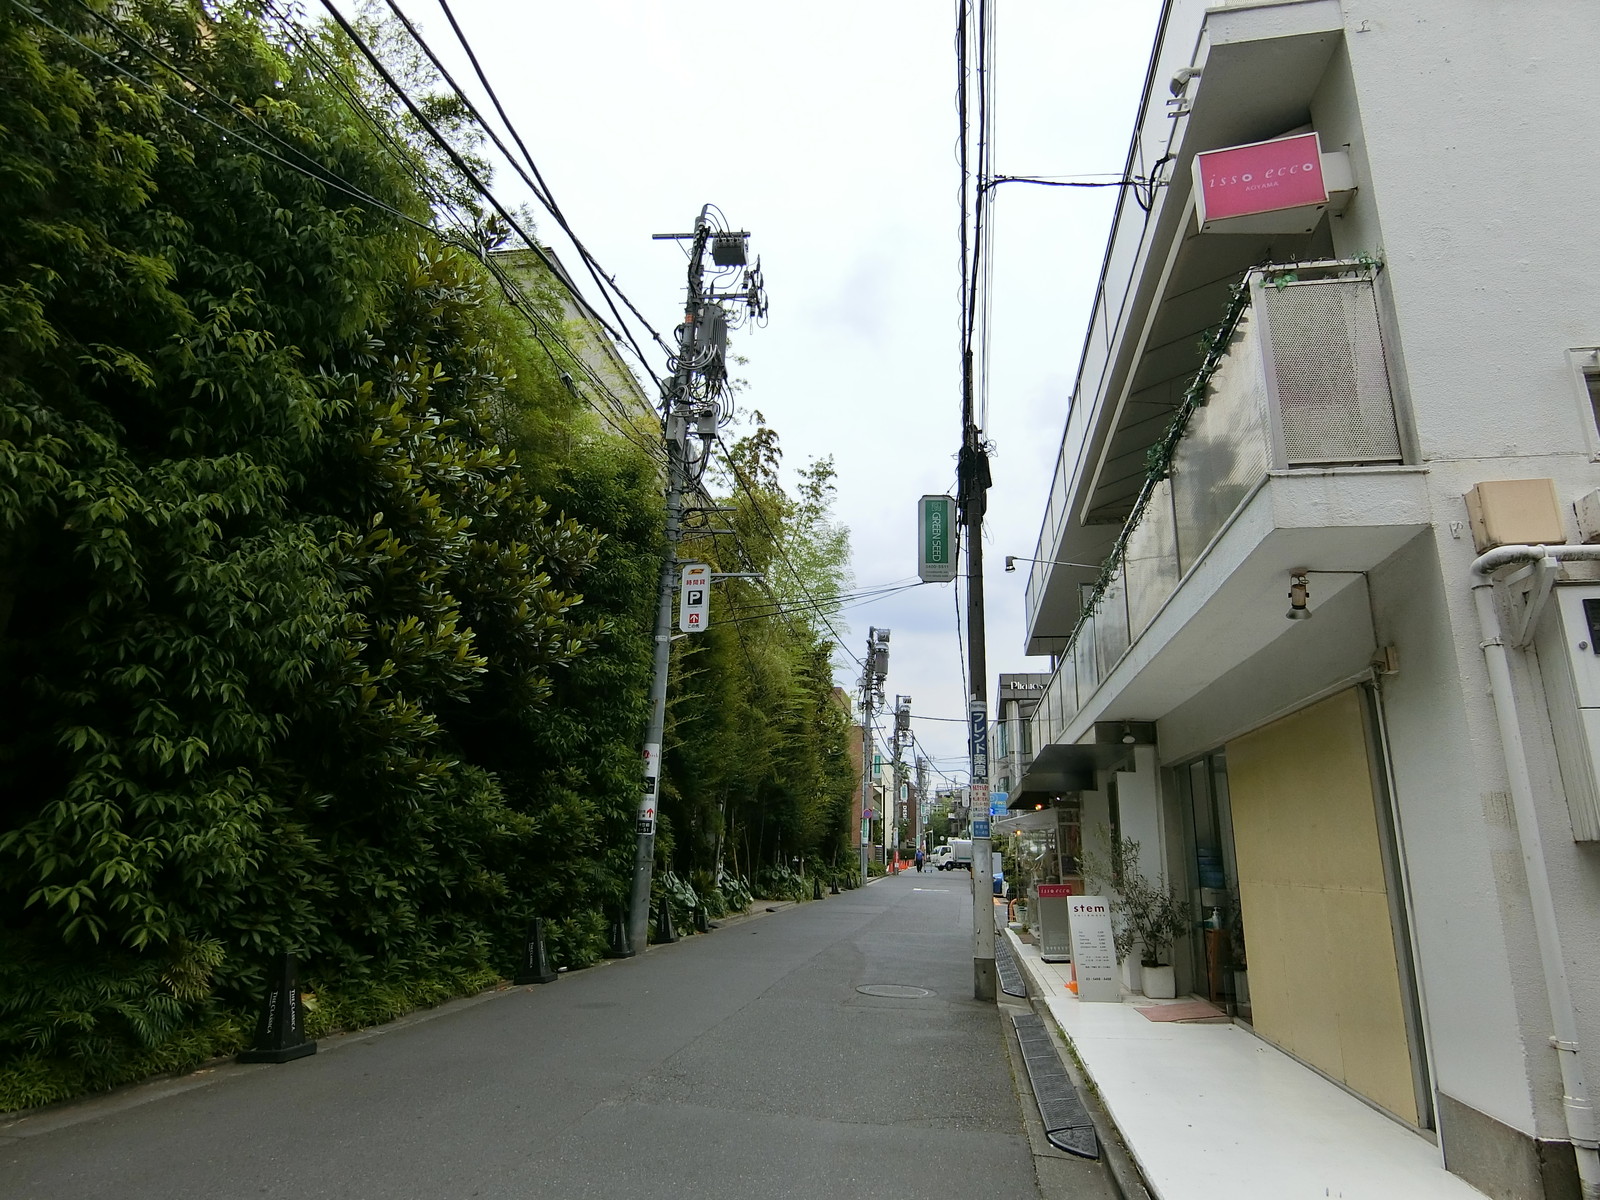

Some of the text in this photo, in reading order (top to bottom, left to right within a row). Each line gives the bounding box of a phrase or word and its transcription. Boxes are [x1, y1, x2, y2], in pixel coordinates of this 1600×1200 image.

[1209, 163, 1313, 188] isso ecco
[1245, 181, 1279, 191] AOYAMA
[932, 512, 941, 562] GREEN SEED
[973, 712, 986, 776] フレンド薬局
[1073, 904, 1105, 912] stem
